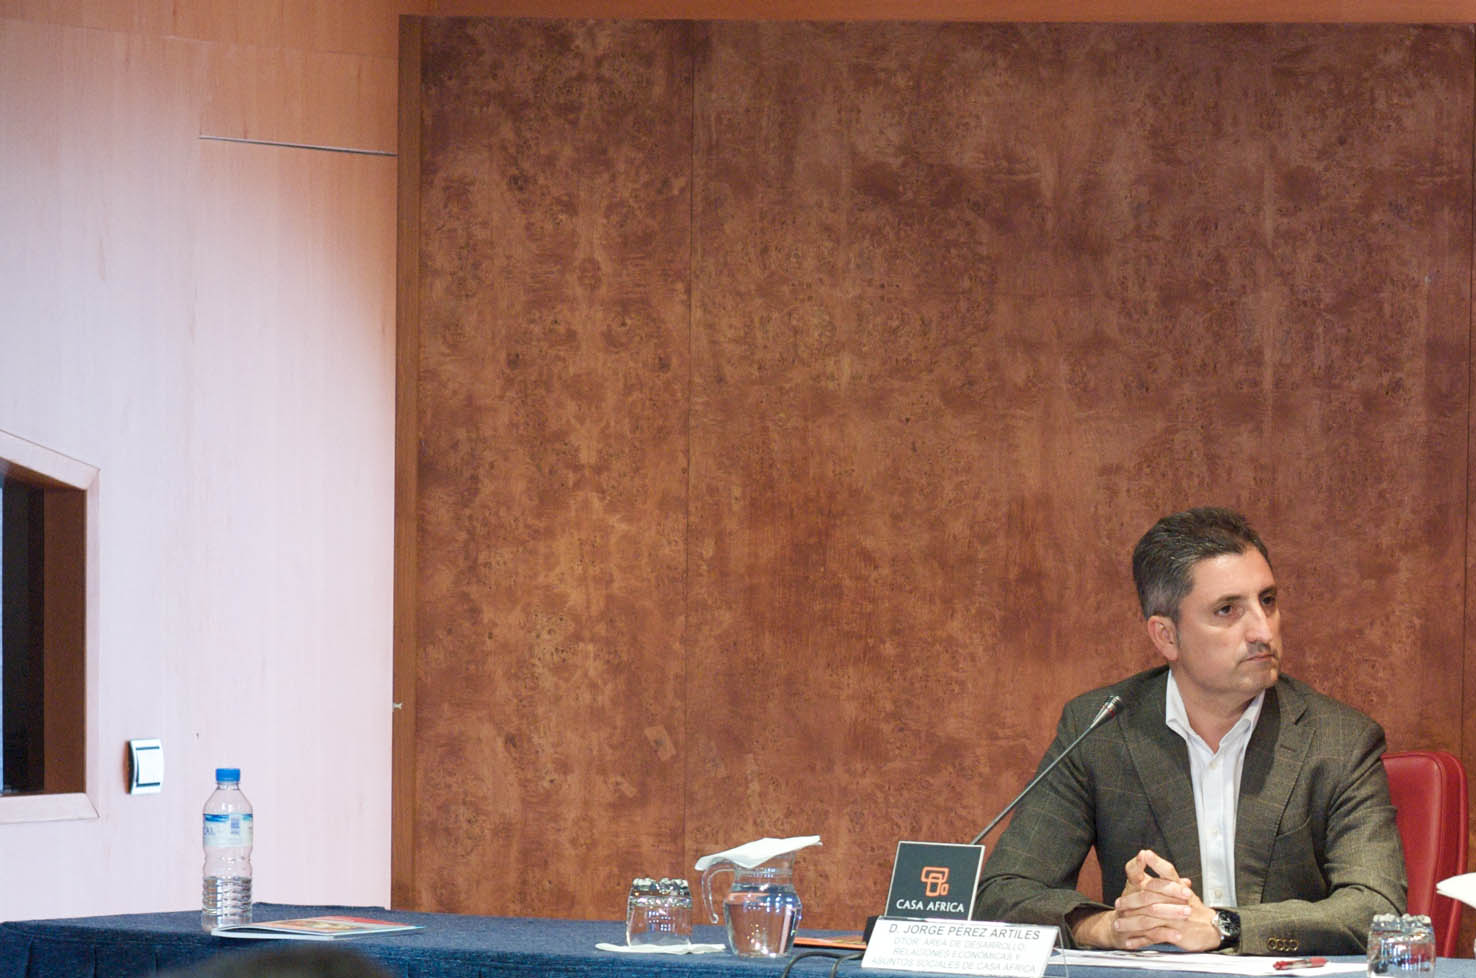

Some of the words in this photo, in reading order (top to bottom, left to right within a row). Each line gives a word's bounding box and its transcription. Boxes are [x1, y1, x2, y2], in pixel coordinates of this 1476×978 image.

[896, 899, 923, 911] CASA
[926, 901, 965, 913] AFRICA
[903, 924, 945, 936] JORGE
[990, 928, 1041, 940] ARTILES
